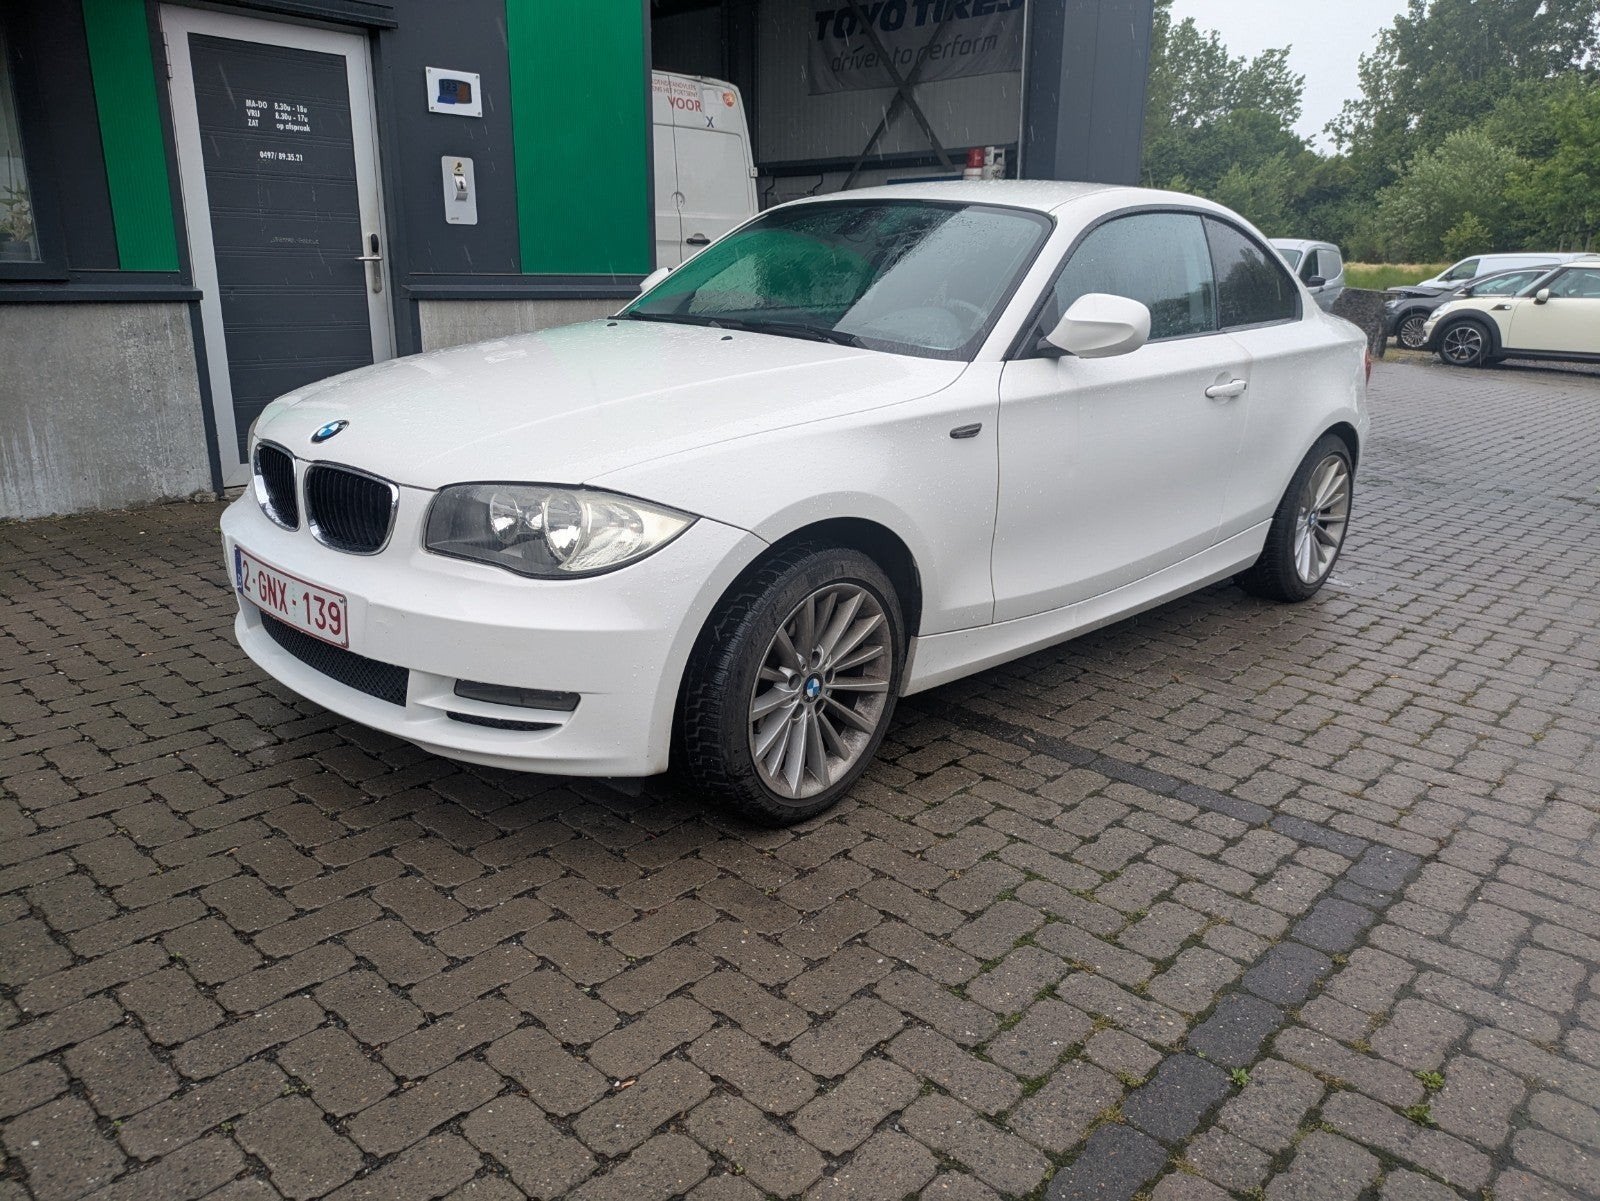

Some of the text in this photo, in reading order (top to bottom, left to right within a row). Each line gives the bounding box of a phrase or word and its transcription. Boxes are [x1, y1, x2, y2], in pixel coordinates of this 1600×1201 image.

[815, 0, 908, 41] TOYO
[893, 45, 912, 65] to
[246, 99, 267, 109] MA-DO
[274, 102, 291, 111] 8.30u
[296, 104, 308, 114] 18u
[667, 96, 702, 112] VOOR
[246, 109, 261, 118] VRIJ
[275, 112, 292, 121] 8.30u
[297, 114, 309, 123] 17u
[248, 119, 258, 127] ZAT
[285, 122, 311, 132] afspraak
[278, 152, 303, 161] 89.35.21
